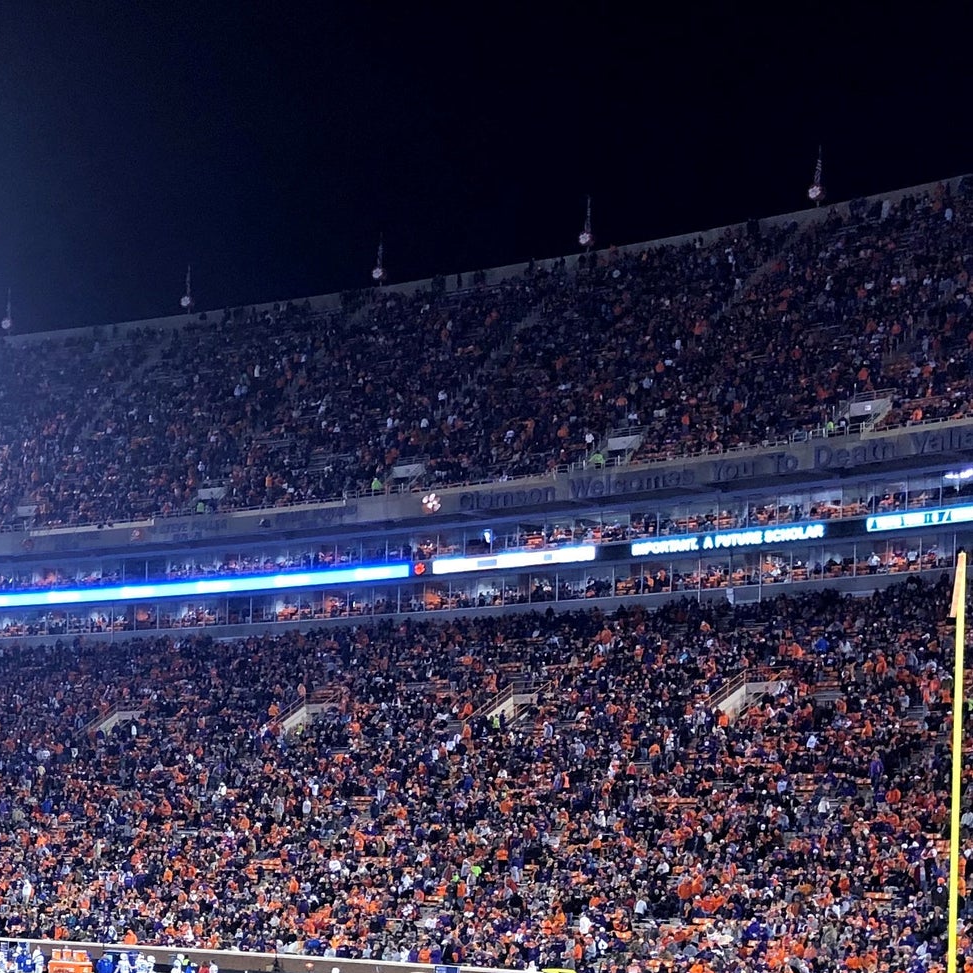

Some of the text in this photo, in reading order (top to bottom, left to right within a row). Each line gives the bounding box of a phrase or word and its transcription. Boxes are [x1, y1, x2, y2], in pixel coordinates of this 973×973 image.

[814, 436, 895, 470] Death
[715, 531, 763, 548] FUTURE
[765, 524, 824, 543] SCHOLAR
